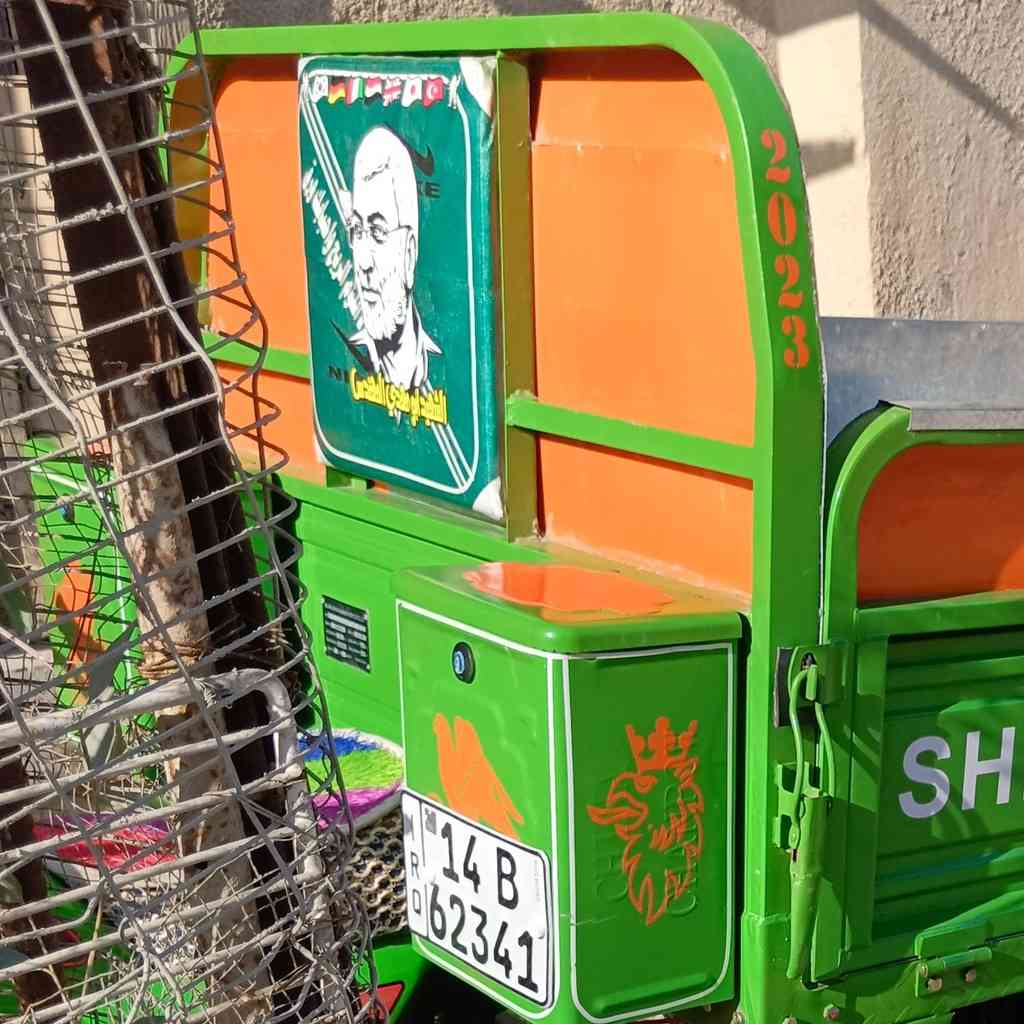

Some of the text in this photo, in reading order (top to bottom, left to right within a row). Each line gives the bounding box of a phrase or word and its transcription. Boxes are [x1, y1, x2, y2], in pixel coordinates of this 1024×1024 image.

[760, 128, 811, 369] 2023
[441, 821, 482, 893] 14
[495, 846, 520, 911] B
[429, 882, 540, 995] 62341
